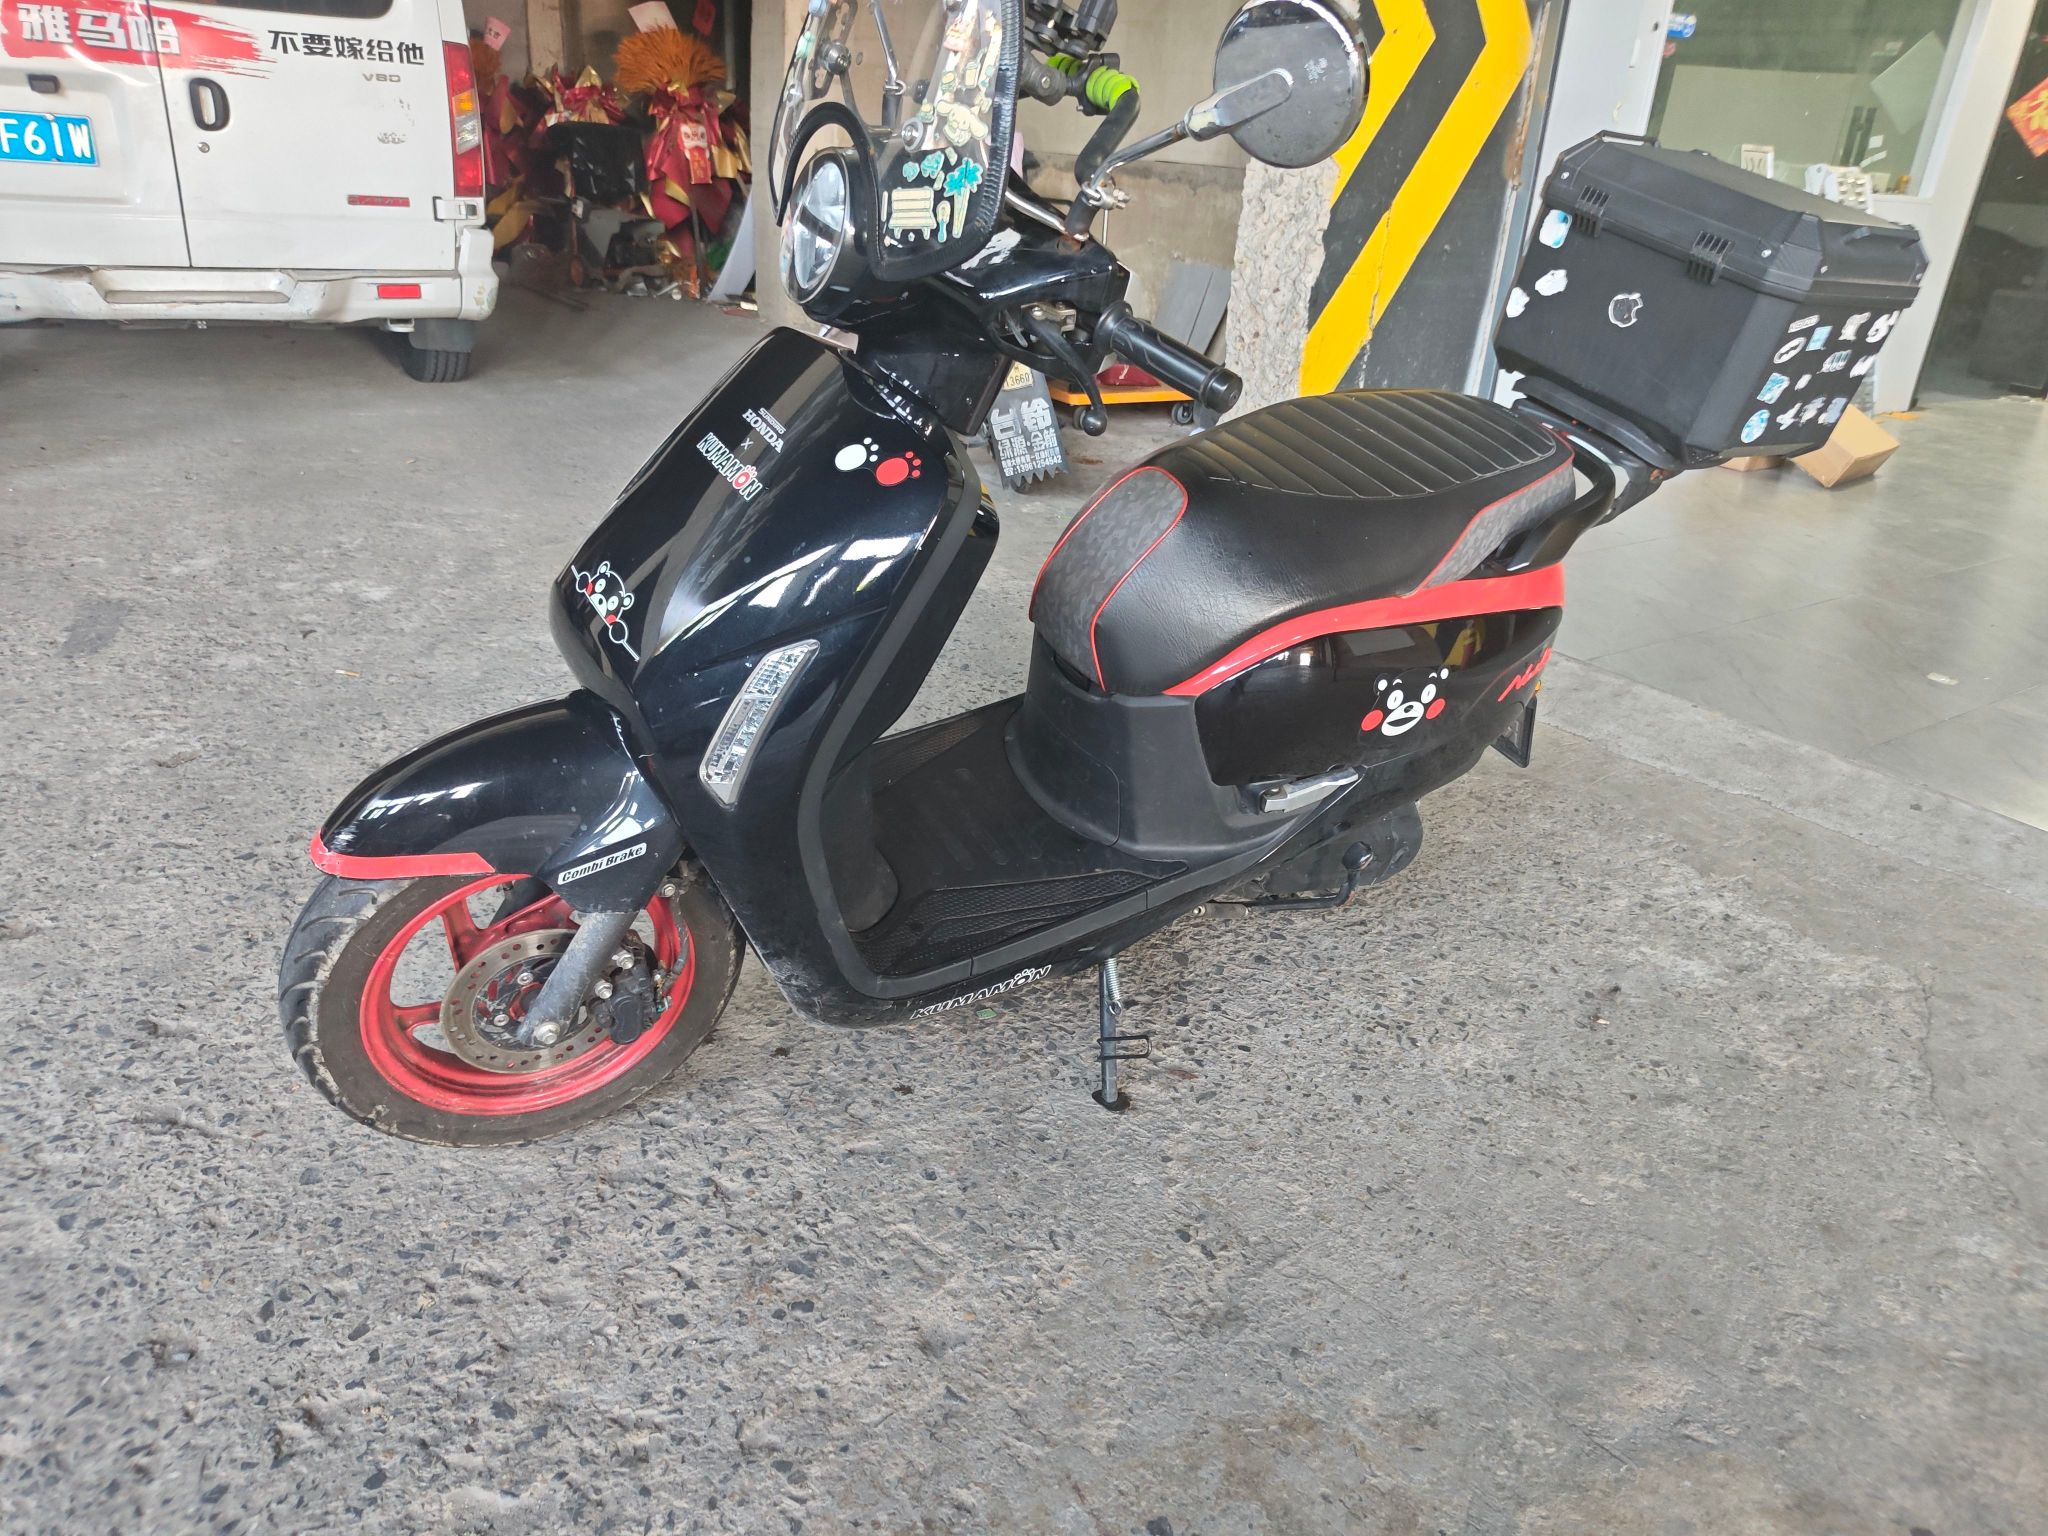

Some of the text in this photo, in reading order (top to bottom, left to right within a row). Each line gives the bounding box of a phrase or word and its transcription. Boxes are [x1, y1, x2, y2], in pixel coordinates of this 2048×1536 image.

[17, 3, 181, 55] 雅马哈
[267, 29, 425, 66] 不要嫁给他
[741, 408, 785, 453] HONDA
[696, 431, 763, 501] KUMAMON
[562, 846, 643, 882] Combi Brake
